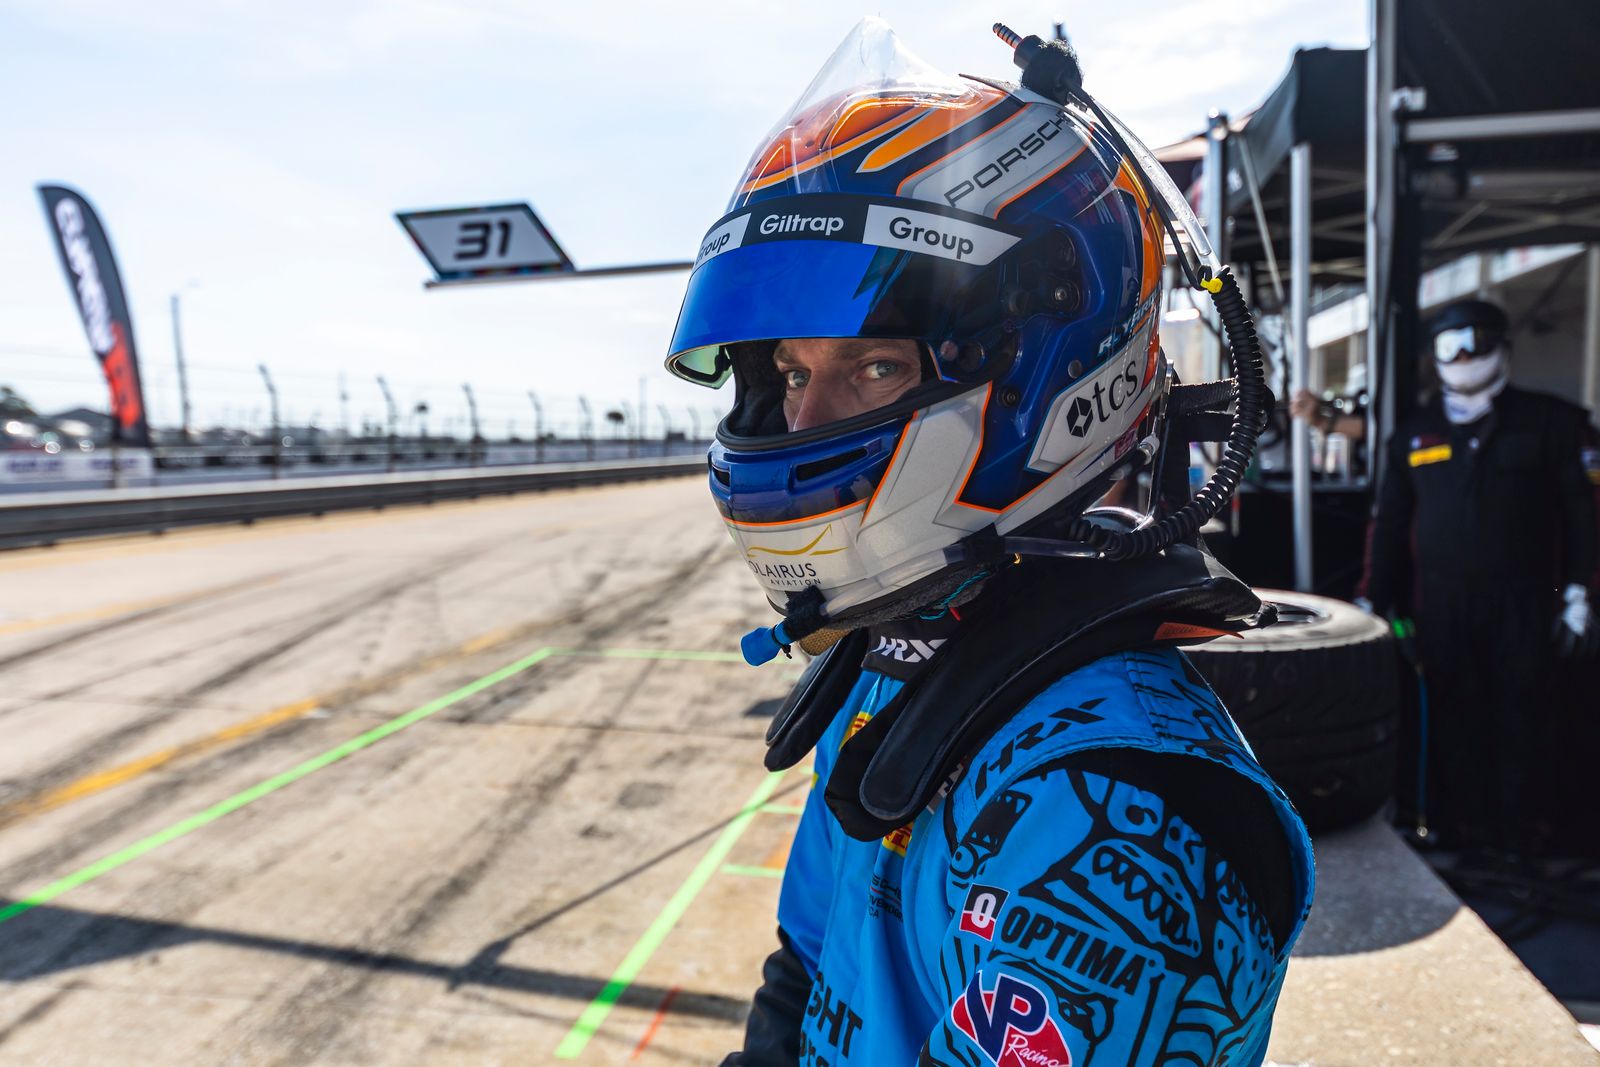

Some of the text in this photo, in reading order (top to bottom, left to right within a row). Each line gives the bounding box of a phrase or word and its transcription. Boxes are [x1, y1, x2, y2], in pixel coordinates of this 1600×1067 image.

[944, 108, 1069, 208] PORSCH
[454, 219, 512, 261] 31
[696, 213, 974, 265] roup Giltrap Group
[1092, 360, 1138, 423] tcs
[770, 578, 821, 586] AVIATION
[871, 635, 948, 663] HRX
[975, 697, 1109, 800] HRX
[1001, 905, 1147, 996] OPTIMA
[965, 970, 1049, 1065] VP
